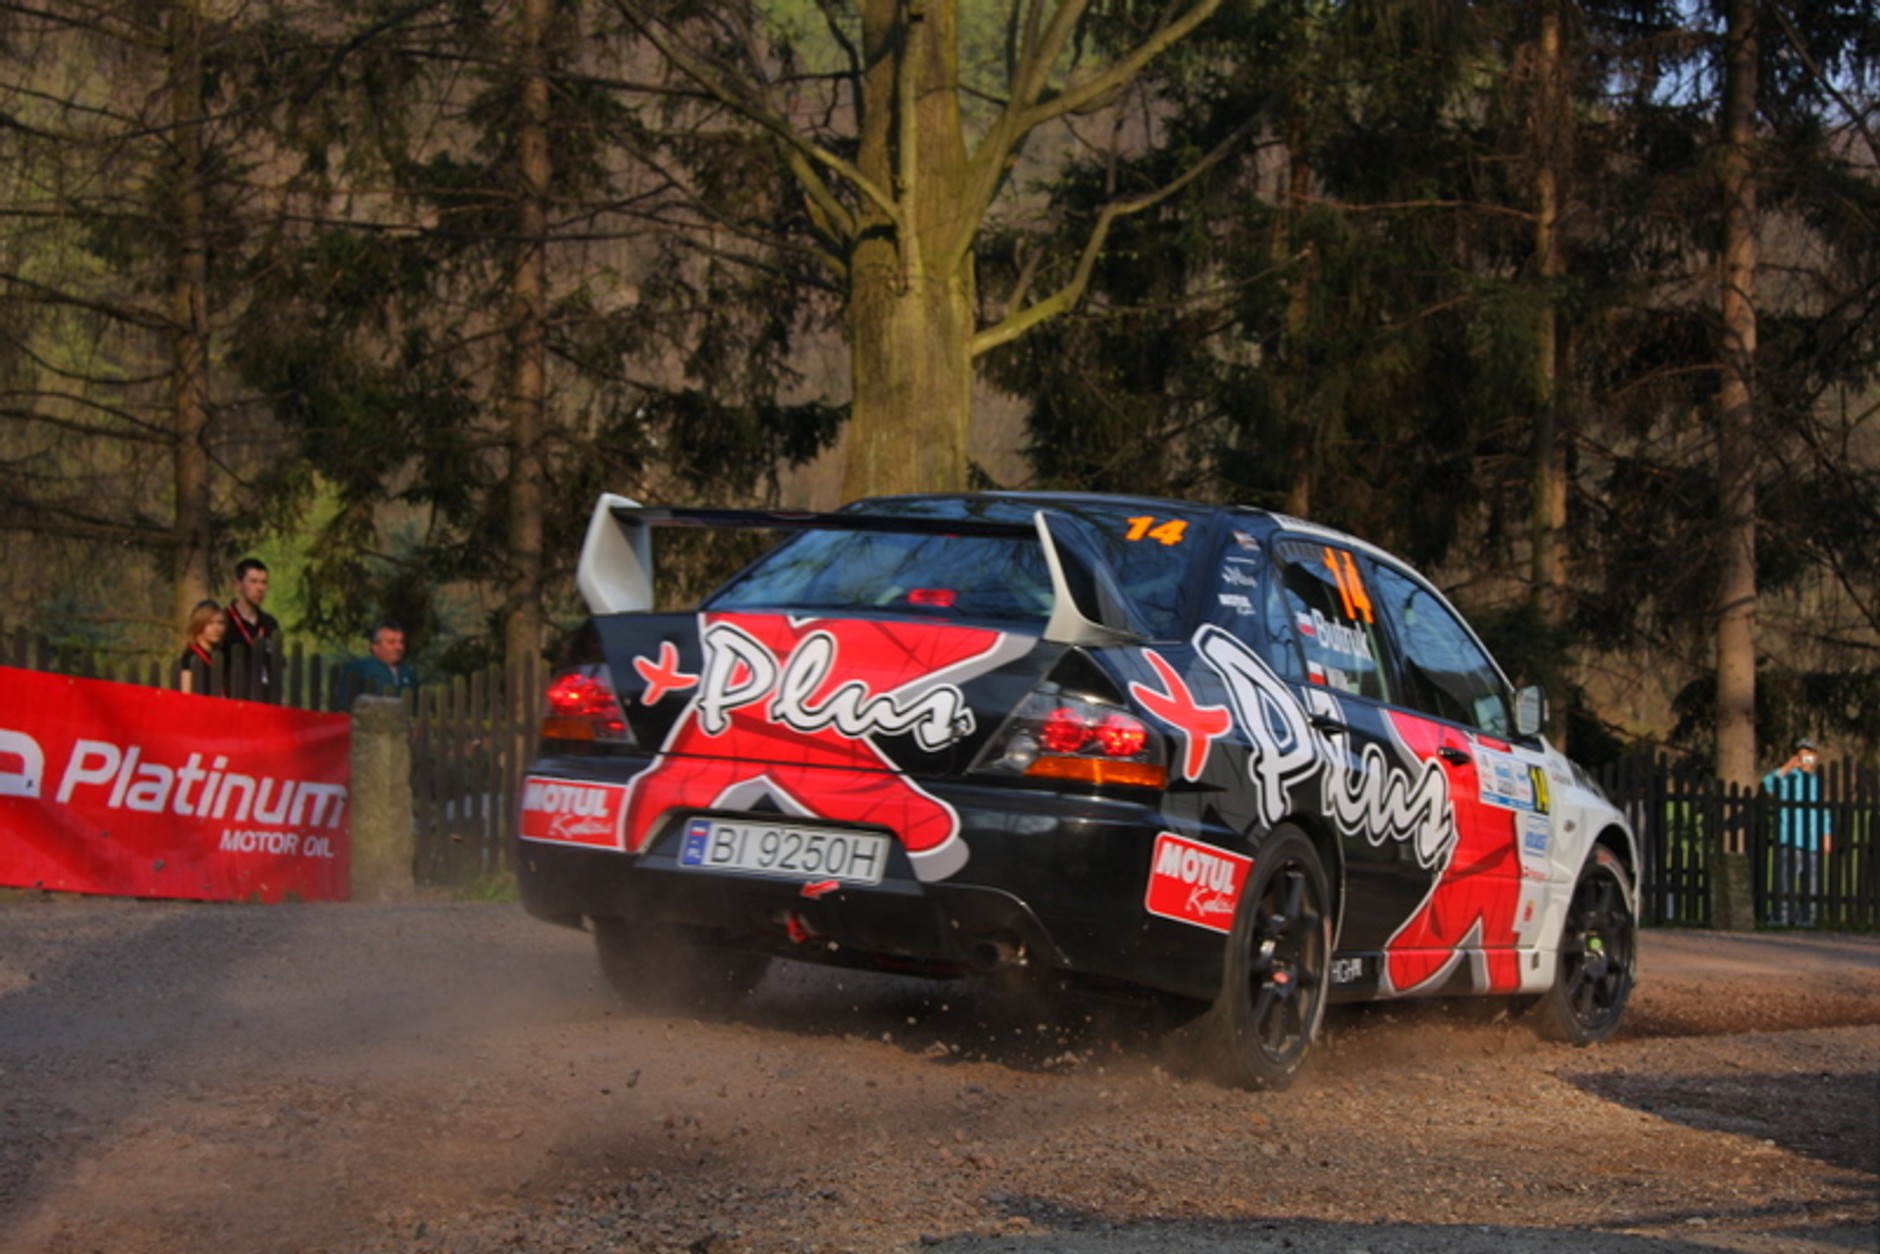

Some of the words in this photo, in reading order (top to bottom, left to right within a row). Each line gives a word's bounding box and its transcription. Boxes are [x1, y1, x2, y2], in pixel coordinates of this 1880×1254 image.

[1125, 516, 1189, 546] 14
[700, 621, 974, 750] Plus
[56, 739, 348, 829] Platinum
[522, 783, 609, 818] MOTUL
[219, 829, 299, 856] MOTOR
[303, 835, 335, 858] OIL
[711, 827, 748, 864] BI
[757, 831, 879, 878] 9250H
[1155, 841, 1236, 895] MOTUL
